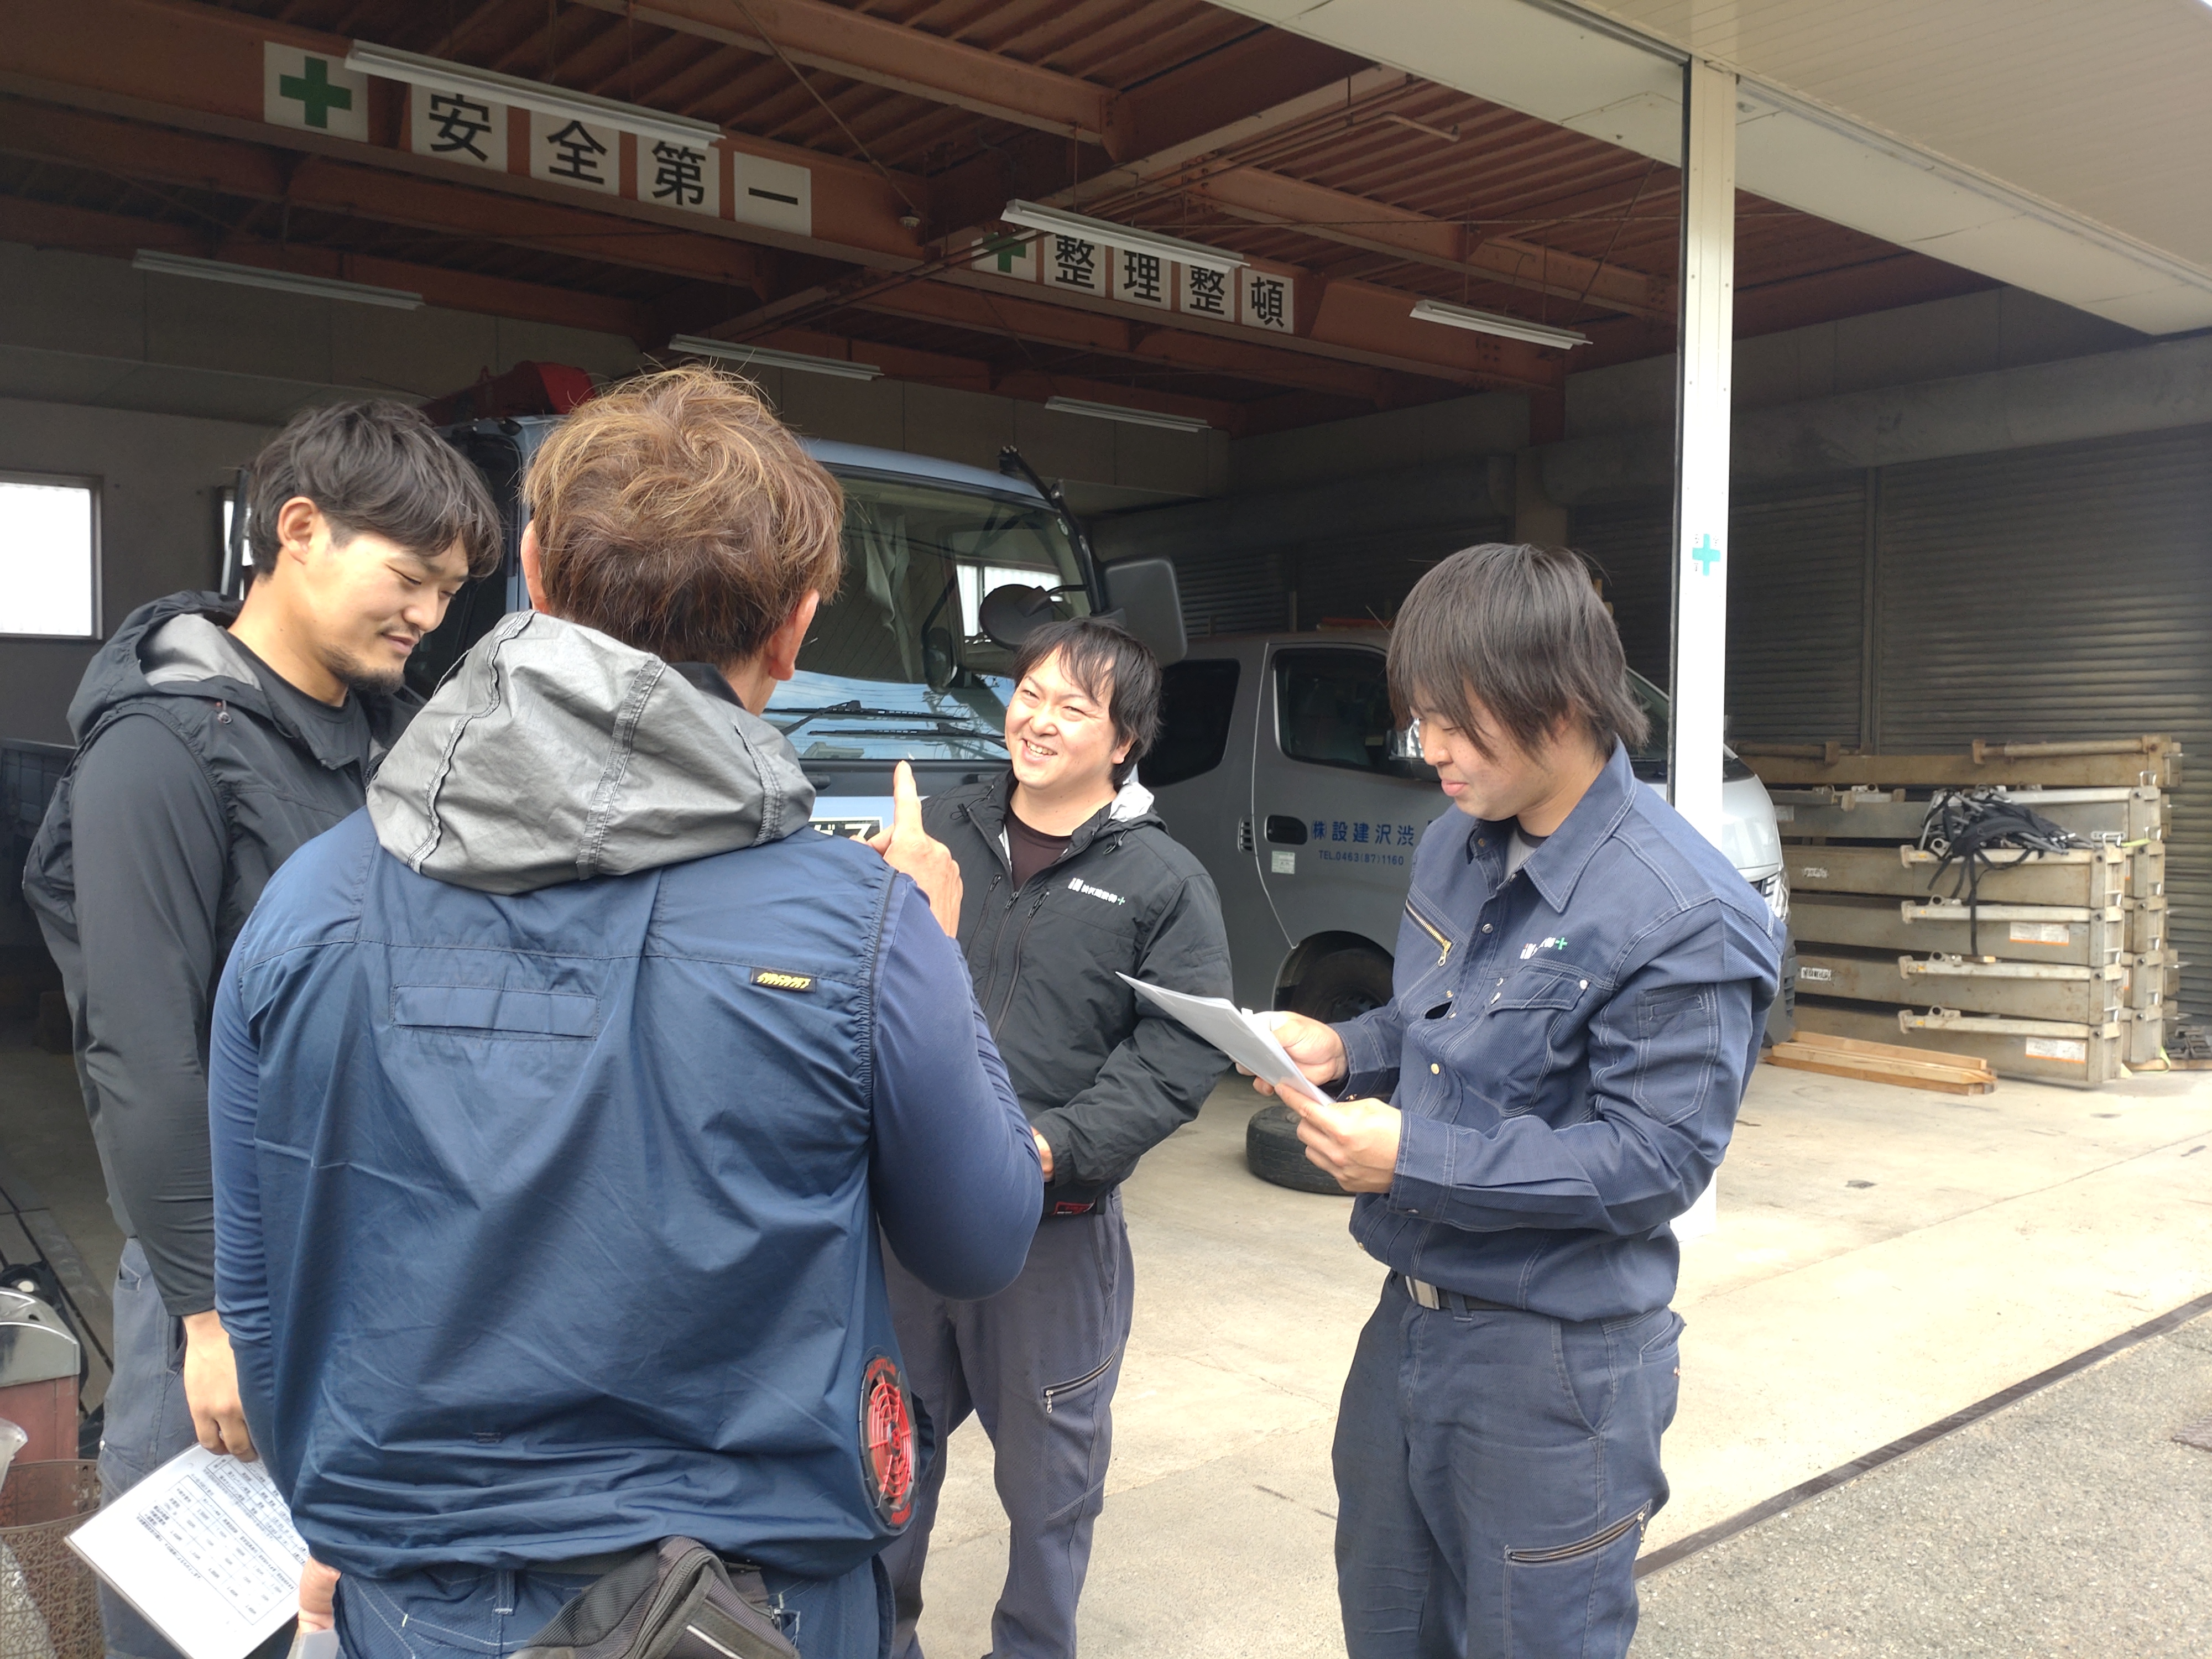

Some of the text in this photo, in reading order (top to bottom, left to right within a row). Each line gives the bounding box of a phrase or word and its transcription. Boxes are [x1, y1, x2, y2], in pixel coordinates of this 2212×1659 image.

[429, 93, 799, 206] 安全第一
[1055, 234, 1285, 328] 整理整頓
